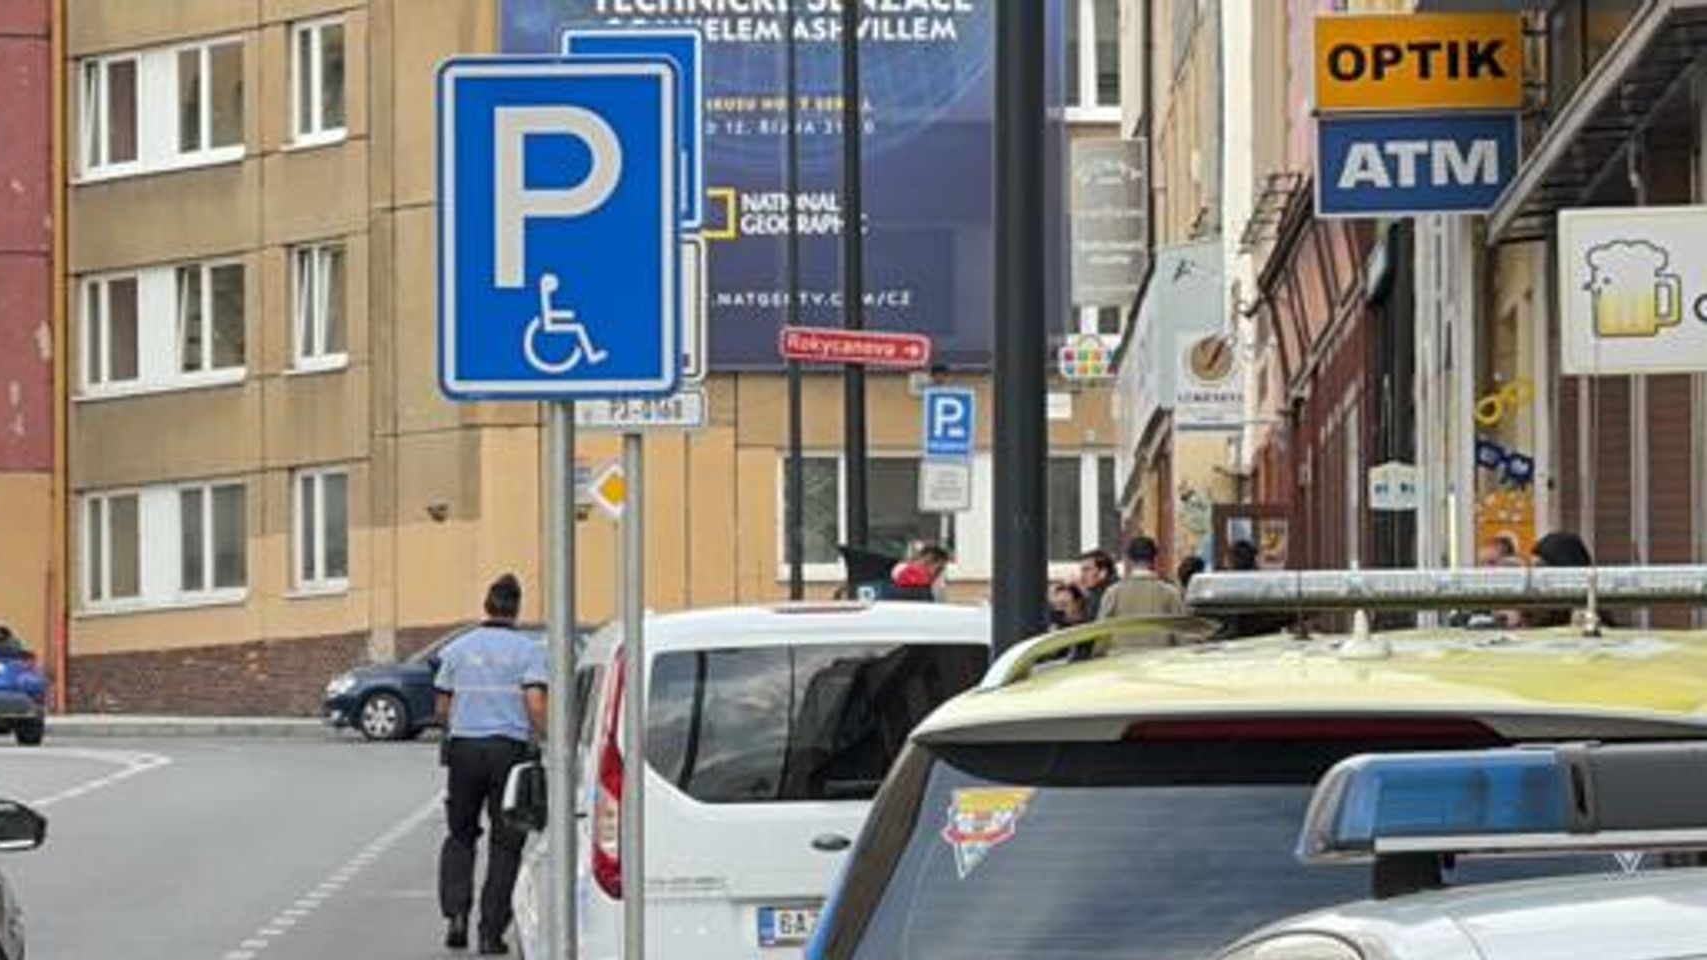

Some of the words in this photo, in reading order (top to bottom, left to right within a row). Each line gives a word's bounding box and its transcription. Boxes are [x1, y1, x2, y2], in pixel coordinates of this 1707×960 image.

[1328, 39, 1506, 82] OPTIK
[1337, 139, 1498, 188] ATM
[494, 106, 622, 287] P
[788, 333, 896, 358] Rokycanova
[935, 398, 965, 438] P
